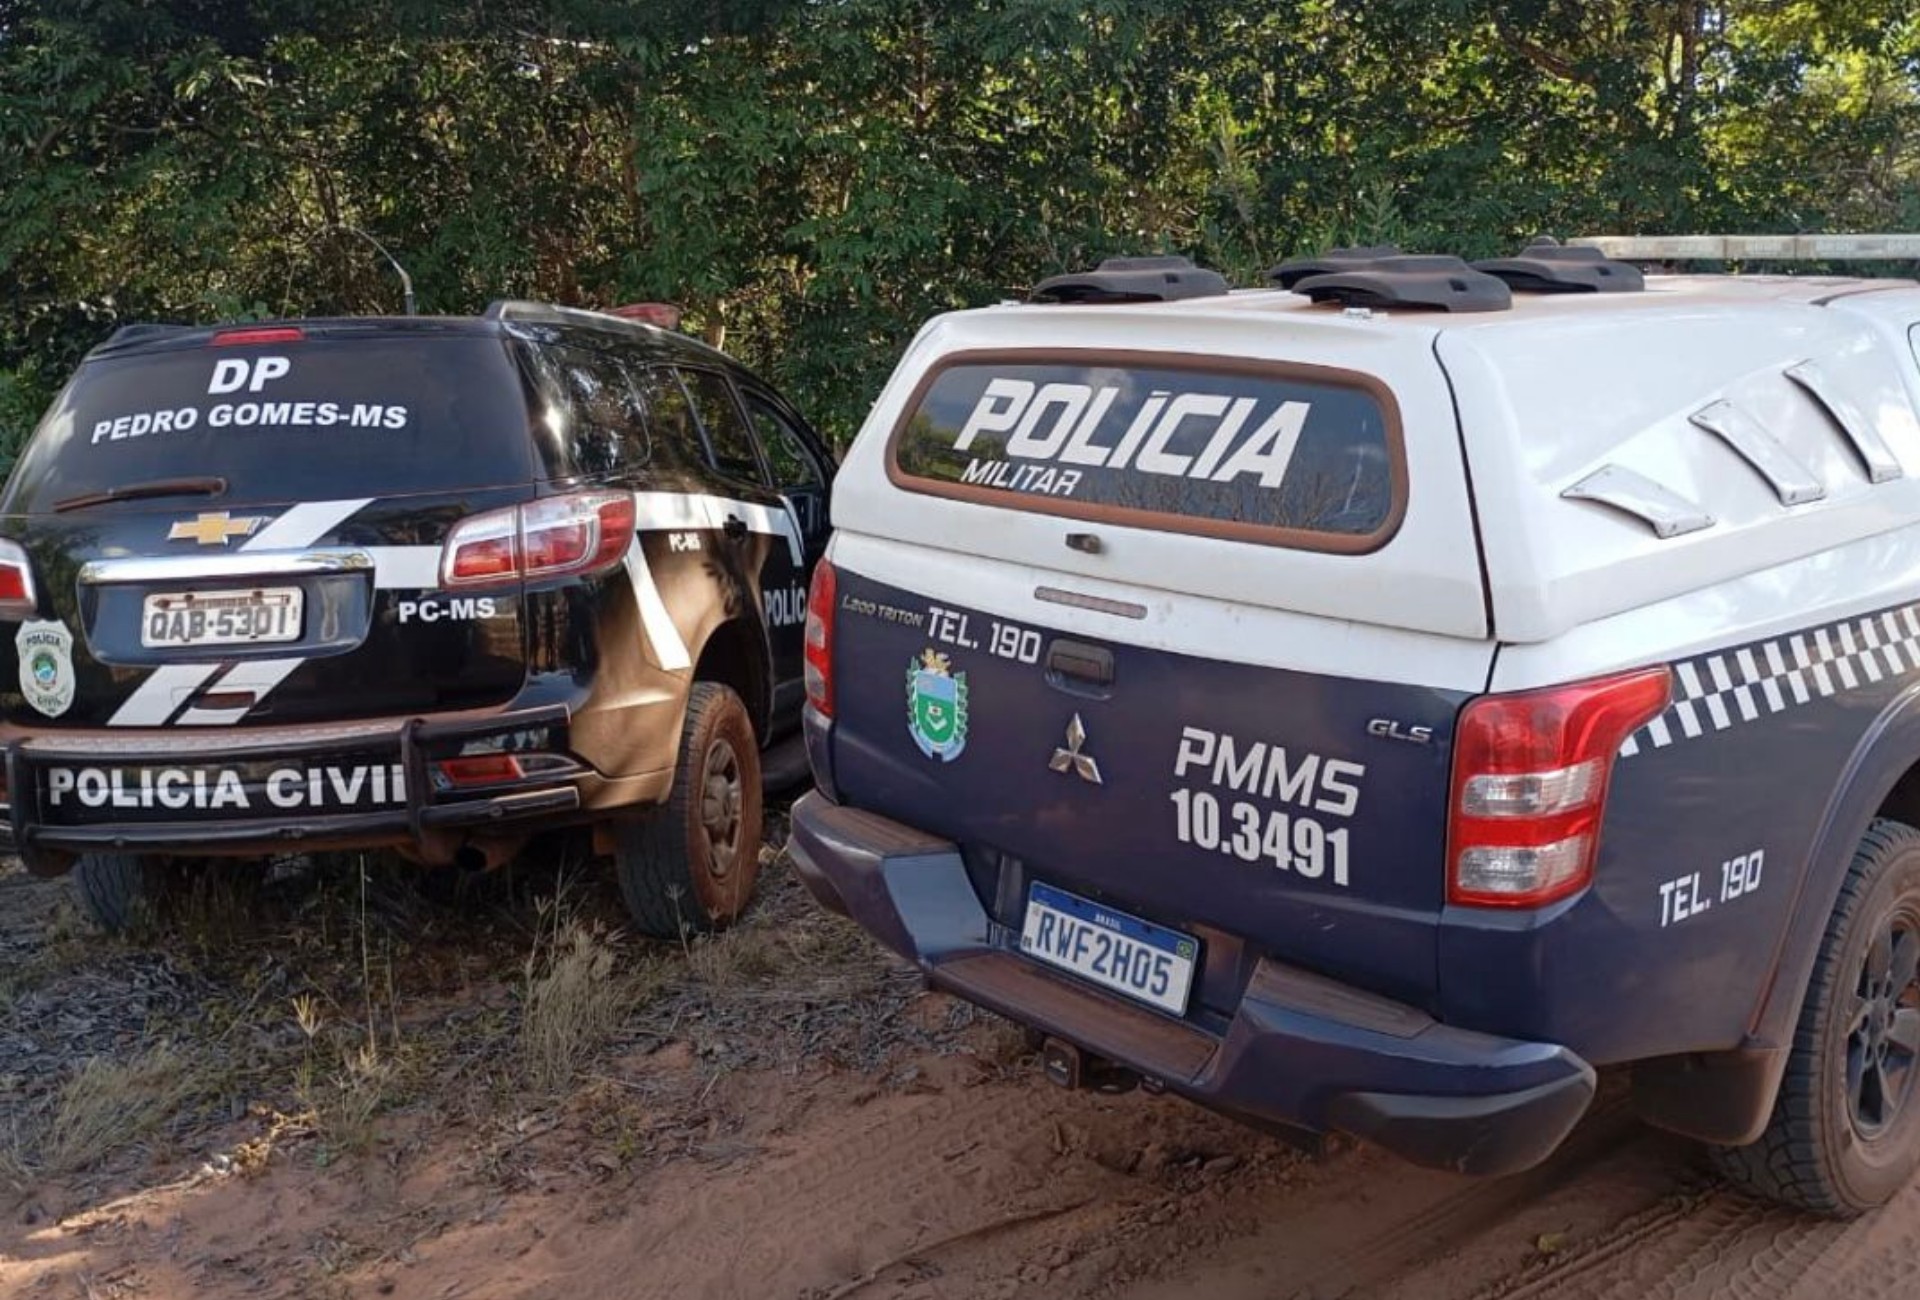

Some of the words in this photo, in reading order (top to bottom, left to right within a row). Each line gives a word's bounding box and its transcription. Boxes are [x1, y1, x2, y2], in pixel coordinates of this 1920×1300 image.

[208, 356, 290, 394] DP
[91, 407, 197, 443] PEDRO
[208, 402, 408, 428] GOMES-MS
[953, 378, 1310, 489] POLÍCIA
[960, 457, 1083, 497] MILITAR
[399, 598, 496, 623] PC-MS
[842, 594, 876, 617] L200
[878, 605, 924, 627] TRITON
[929, 606, 979, 649] TEL.
[990, 621, 1042, 664] 190
[1367, 719, 1433, 742] GLS
[49, 768, 250, 809] POLICIA
[1174, 726, 1366, 817] PMMS
[1171, 788, 1350, 887] 10.3491
[1659, 872, 1711, 928] TEL.
[1720, 849, 1764, 902] 190
[1037, 911, 1173, 997] RWF2H05
